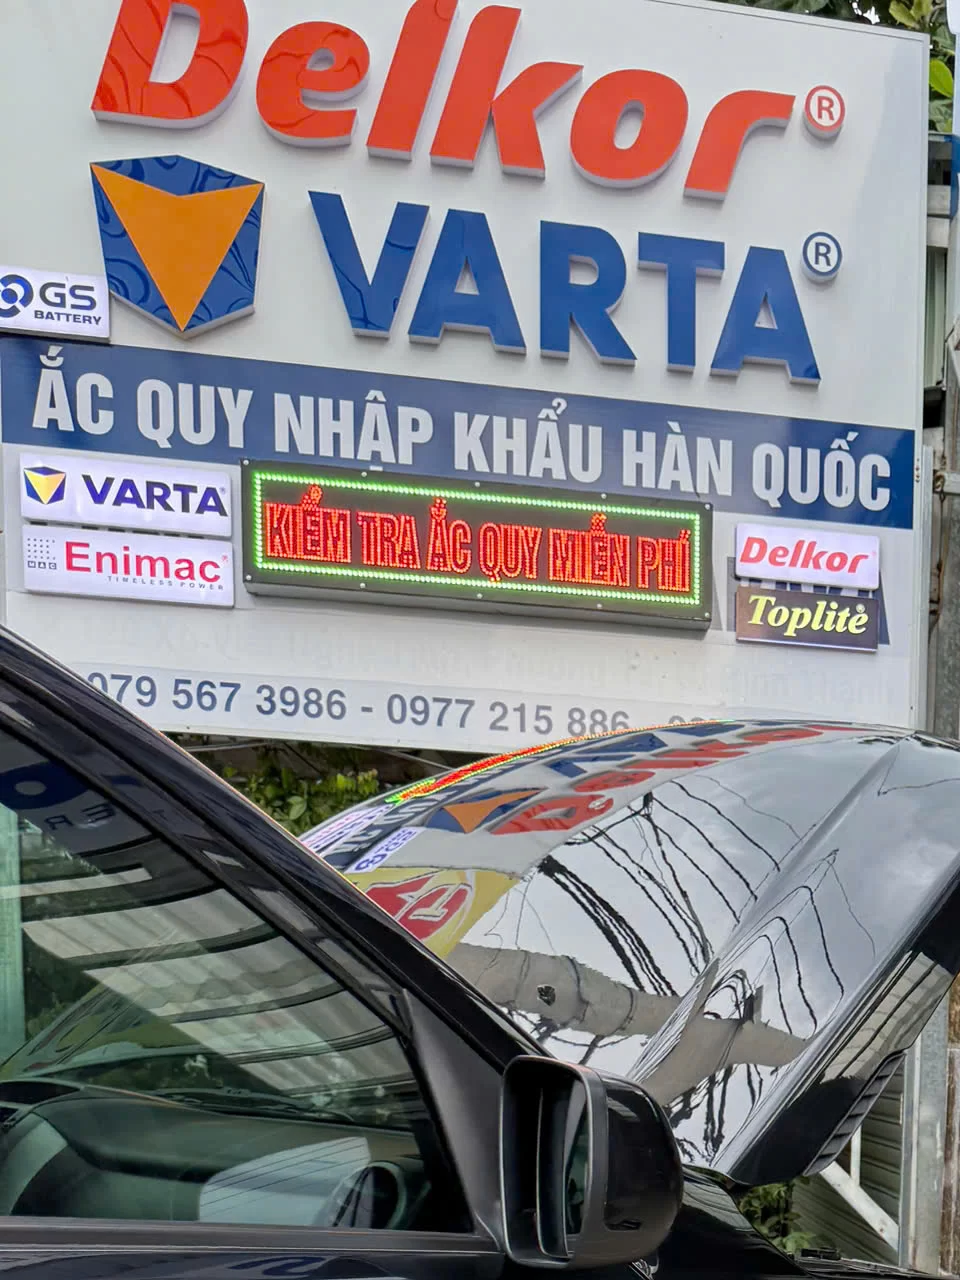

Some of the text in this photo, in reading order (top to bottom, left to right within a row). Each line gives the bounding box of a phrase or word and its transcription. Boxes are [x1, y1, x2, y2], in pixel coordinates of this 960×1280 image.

[91, 0, 795, 200] Delkor
[38, 280, 98, 312] GS
[308, 190, 821, 387] VARTA
[34, 309, 102, 326] BATTERY
[32, 345, 892, 513] ẮC QUY NHẬP KHẨU HÀN QUỐC
[81, 474, 229, 517] VARTA
[264, 484, 352, 563] KIỂM
[357, 512, 421, 570] TRA
[426, 497, 472, 573] ẮC
[478, 523, 542, 583] QUY
[637, 529, 690, 591] PHÍ
[739, 536, 869, 574] Delkor
[27, 561, 57, 570] MAC
[65, 541, 222, 584] Enimac
[107, 575, 224, 591] TIMELESS POWER
[171, 678, 241, 712] 567
[255, 684, 346, 721] 3986
[387, 693, 475, 729] 0977
[489, 702, 553, 734] 215
